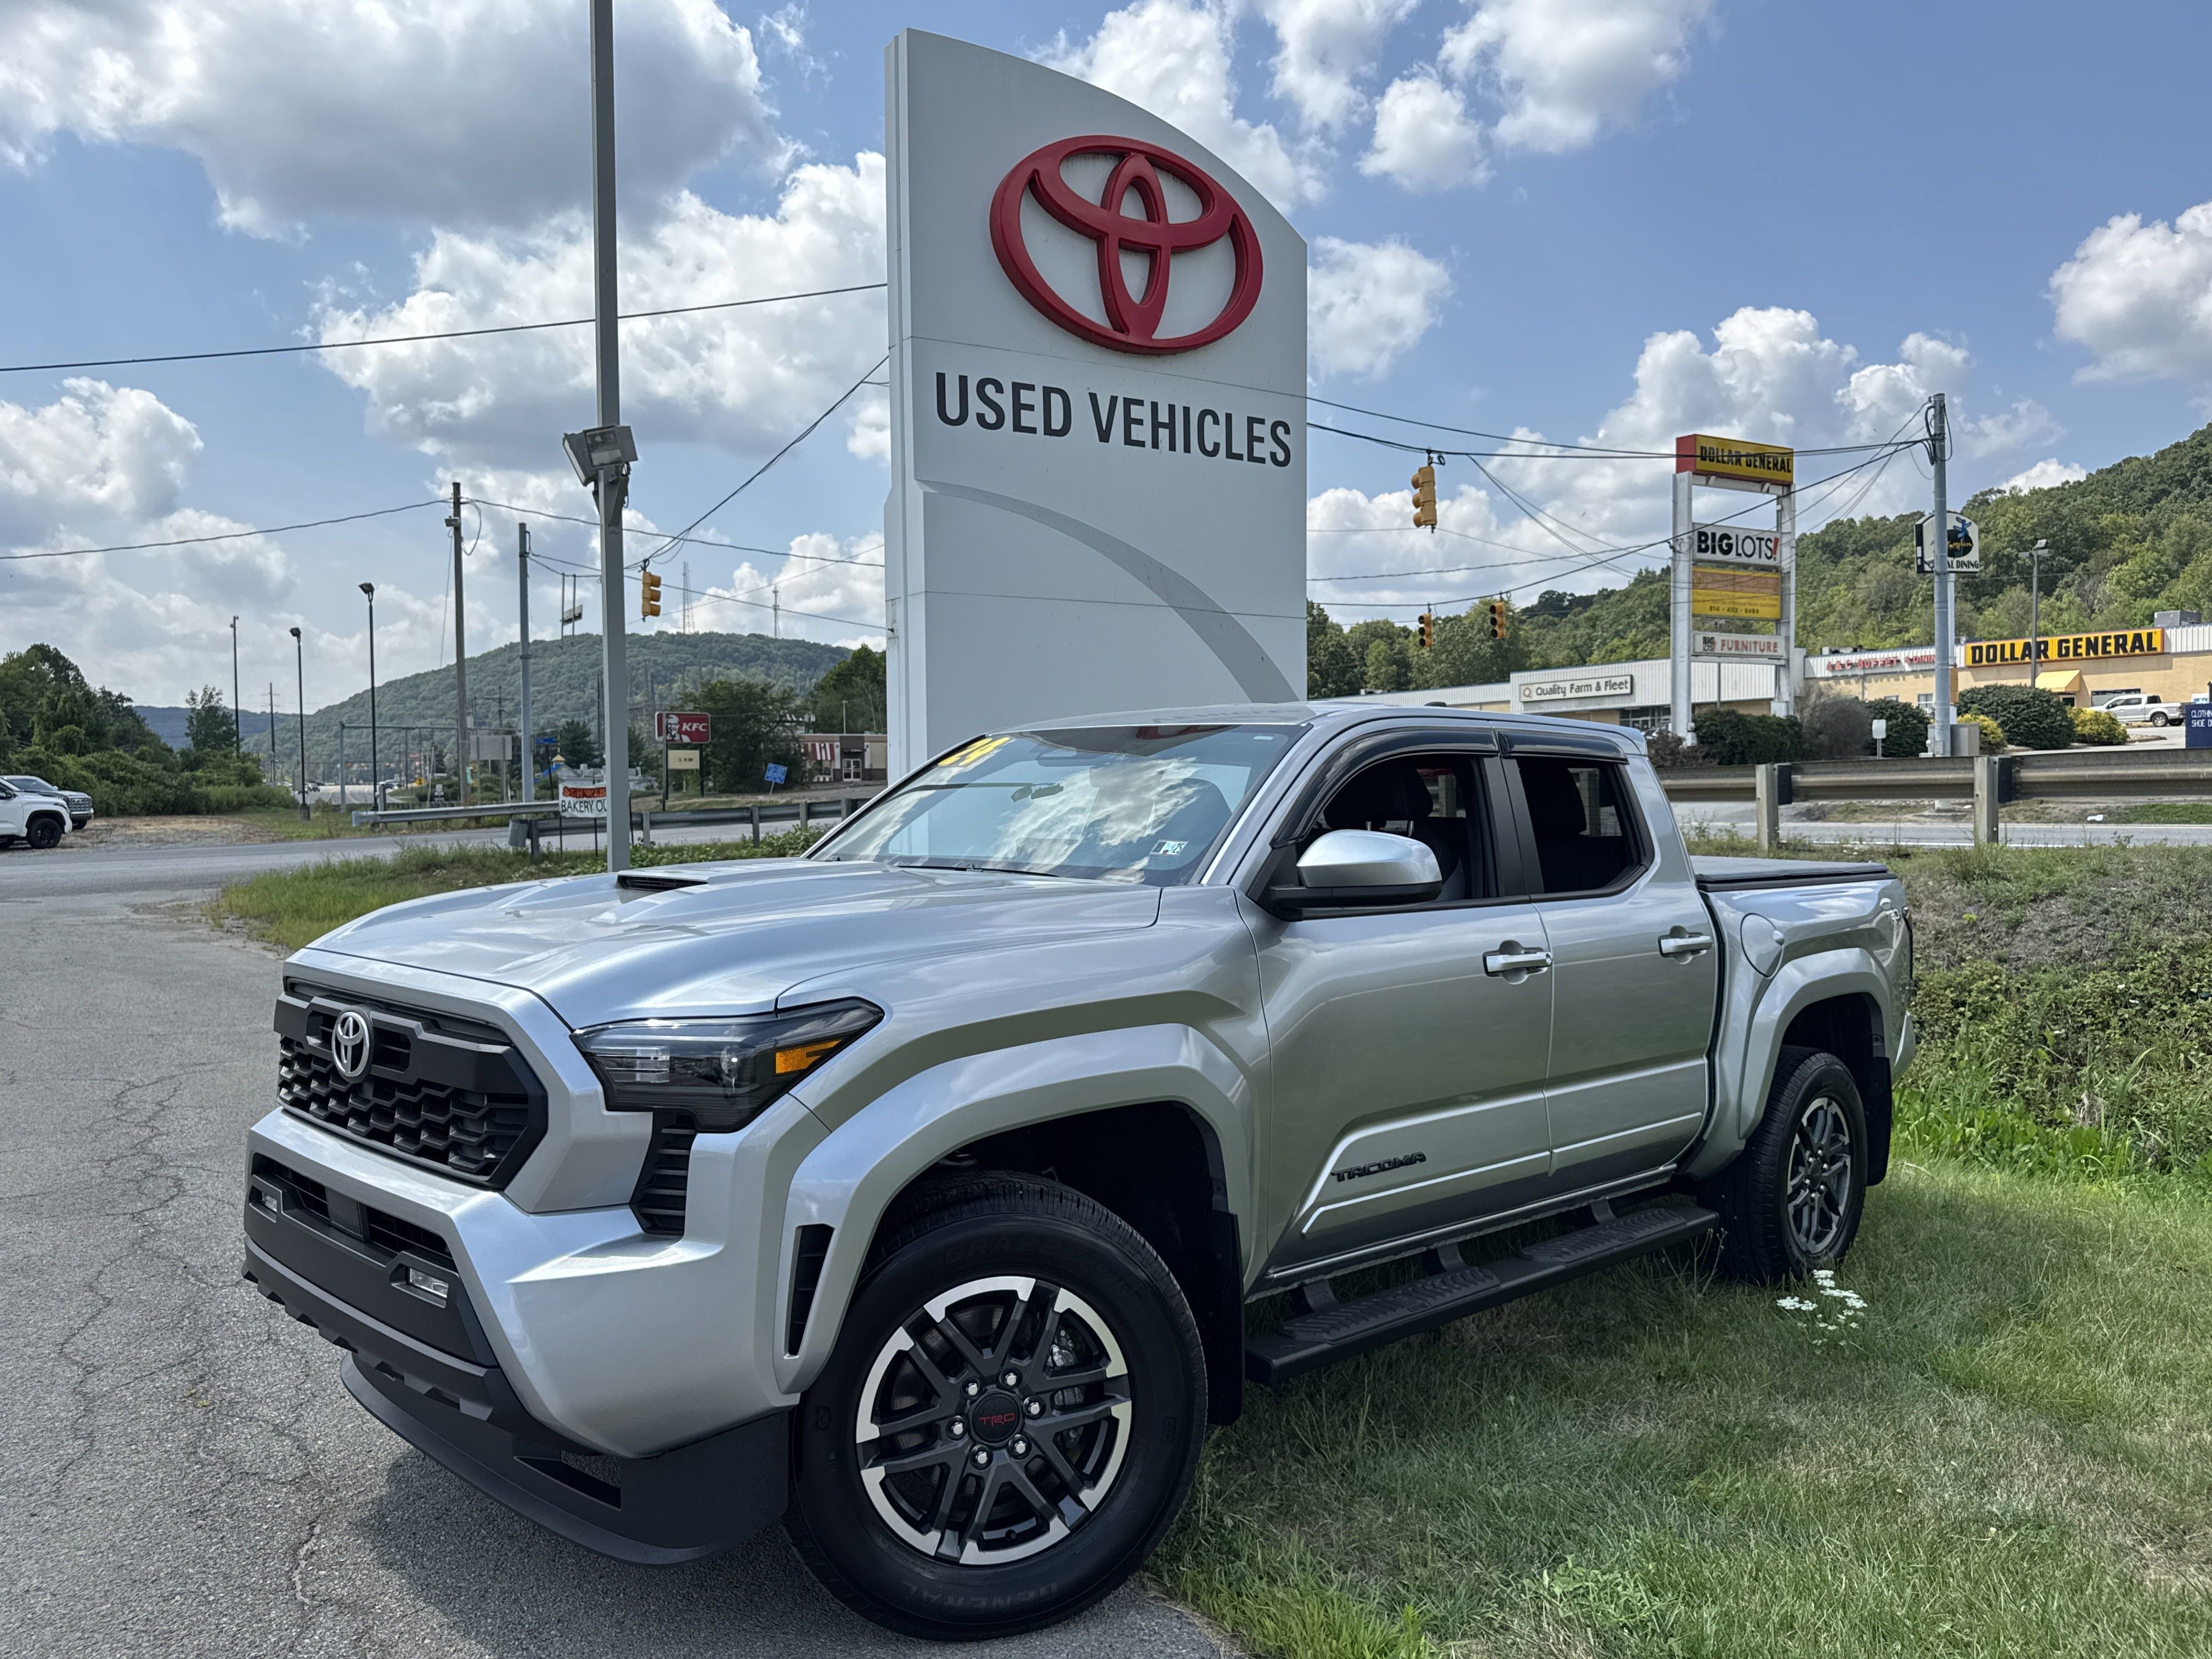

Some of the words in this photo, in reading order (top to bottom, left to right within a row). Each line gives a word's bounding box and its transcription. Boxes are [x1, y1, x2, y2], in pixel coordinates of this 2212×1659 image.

[936, 372, 1072, 437] USED
[1088, 392, 1291, 467] VEHICLES
[1700, 445, 1742, 466] DOLLAR
[1746, 452, 1791, 473] GENERAL
[1697, 531, 1733, 556] BIG
[1735, 534, 1779, 562] LOTS!
[1956, 560, 1979, 569] DINING
[1720, 640, 1778, 653] FURNITURE
[1971, 640, 2049, 664] DOLLAR
[2057, 631, 2158, 658] GENERAL
[1857, 657, 1899, 669] BUFFET
[1913, 654, 1936, 663] DININ
[1536, 684, 1566, 697] Quality
[1570, 684, 1592, 693] Farm
[1595, 681, 1601, 691] &
[1604, 679, 1628, 691] Fleet
[2191, 709, 2212, 718] CLOTHIN
[682, 723, 708, 732] KFC
[2191, 719, 2205, 727] SHOE
[561, 800, 594, 812] BAKERY
[596, 799, 607, 812] OU
[1172, 843, 1186, 854] 25
[1330, 1151, 1426, 1182] TACOMA
[979, 1413, 1015, 1427] TRD
